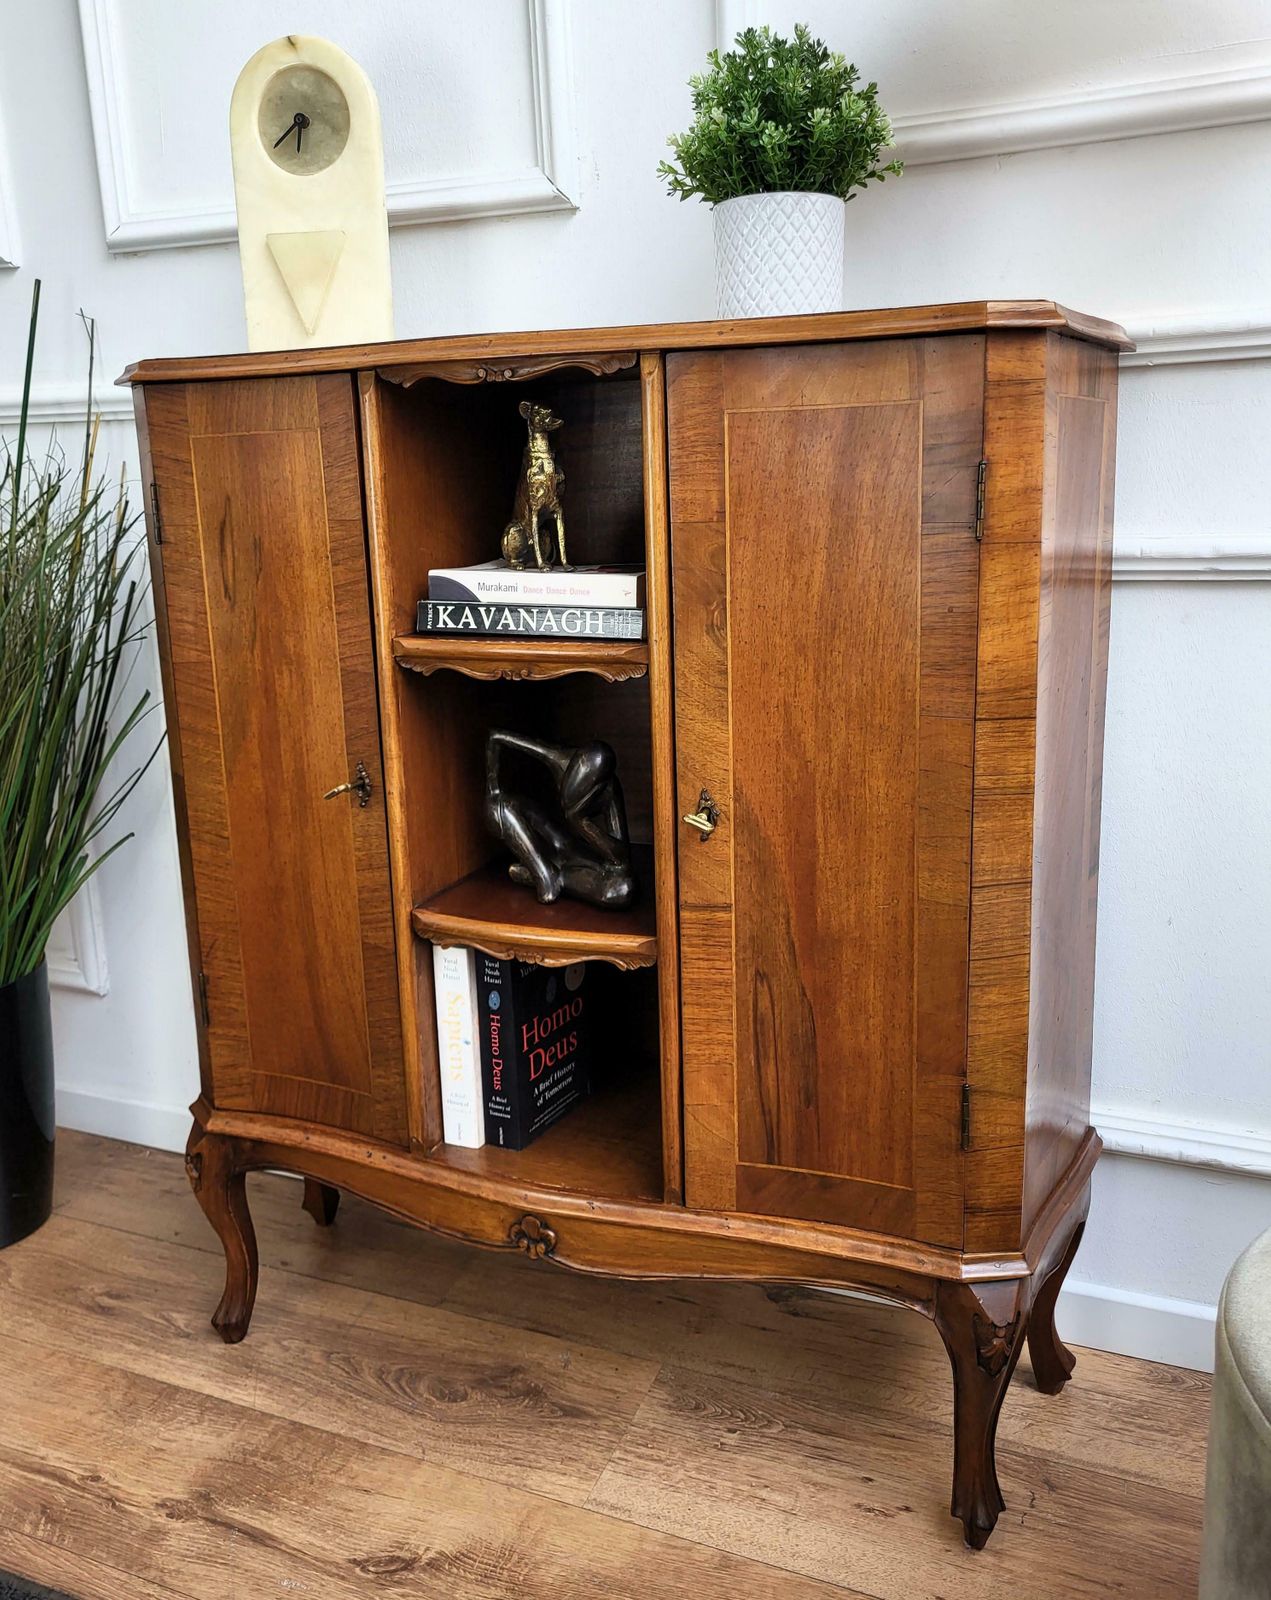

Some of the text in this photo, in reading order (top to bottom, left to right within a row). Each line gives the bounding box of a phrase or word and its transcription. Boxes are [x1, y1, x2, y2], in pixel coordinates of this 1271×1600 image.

[477, 582, 590, 596] Murakami Dance Dance Dance
[436, 605, 606, 635] KAVANAGH
[484, 959, 499, 968] Yuval
[485, 967, 500, 976] Noah
[484, 975, 502, 984] Harari
[520, 996, 584, 1053] Homo
[489, 1014, 503, 1090] Homo Deus
[528, 1030, 578, 1082] Deus
[533, 1061, 576, 1097] A Brief History
[536, 1075, 573, 1107] of Tomorrow
